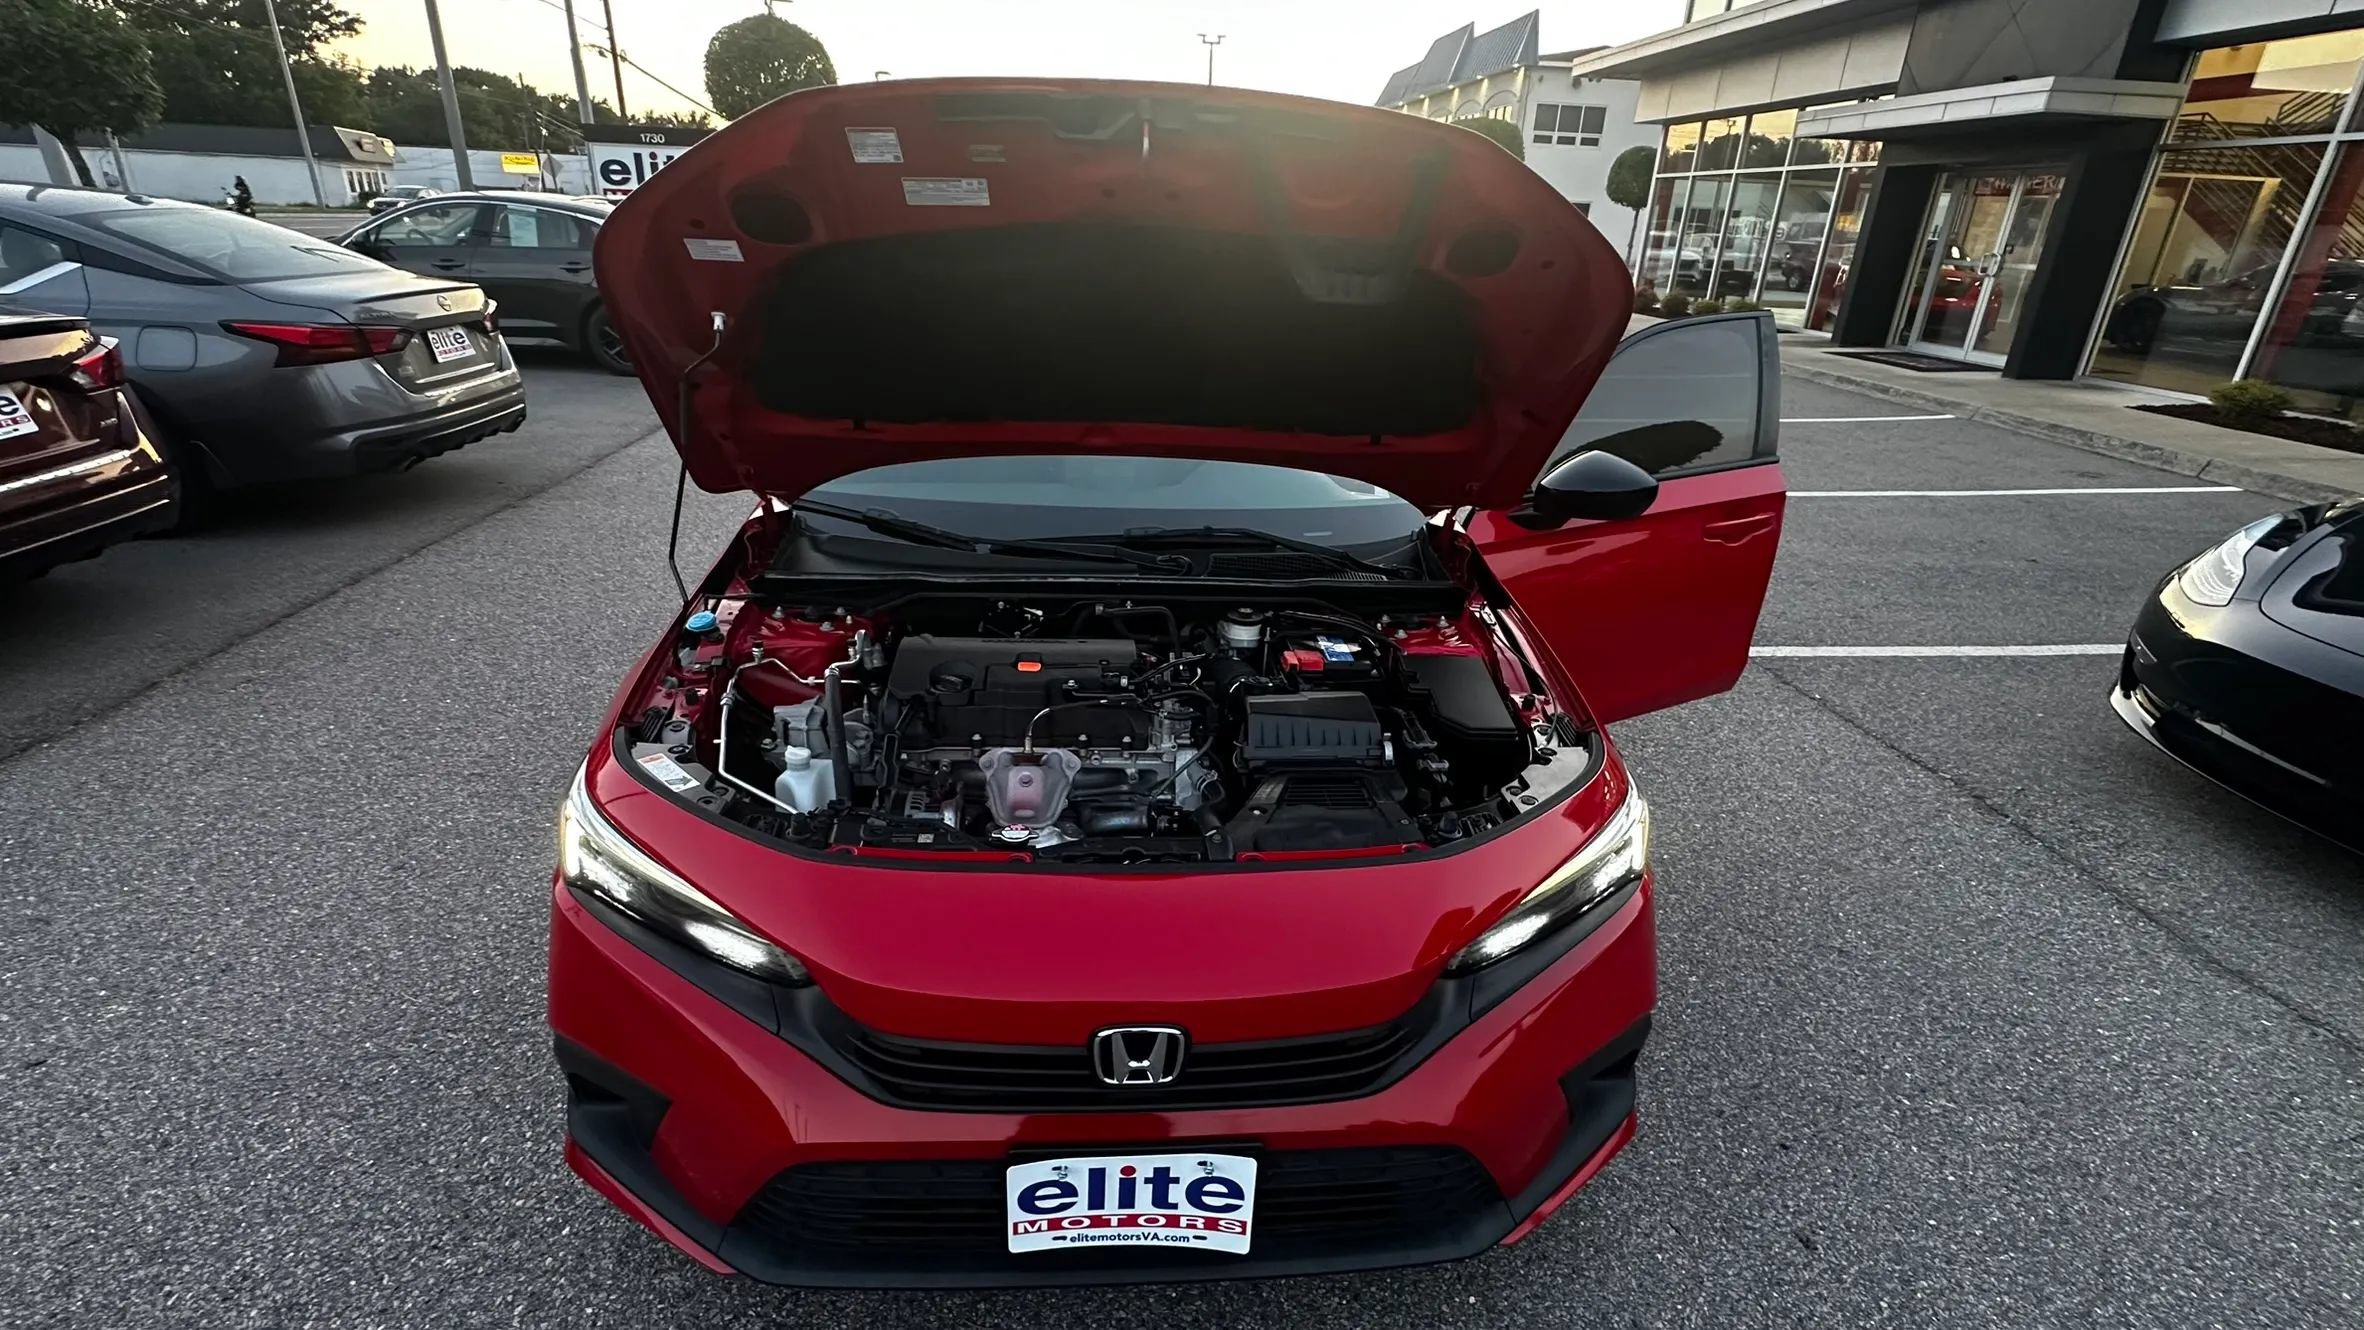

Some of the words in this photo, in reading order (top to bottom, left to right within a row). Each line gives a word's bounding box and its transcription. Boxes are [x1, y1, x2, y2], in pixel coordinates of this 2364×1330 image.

[640, 133, 665, 143] 1730
[600, 151, 675, 186] eli
[431, 332, 466, 349] elite
[1017, 1165, 1245, 1214] elite
[1017, 1215, 1243, 1234] MOTORS
[1069, 1232, 1190, 1243] elitemotorsVA.com
